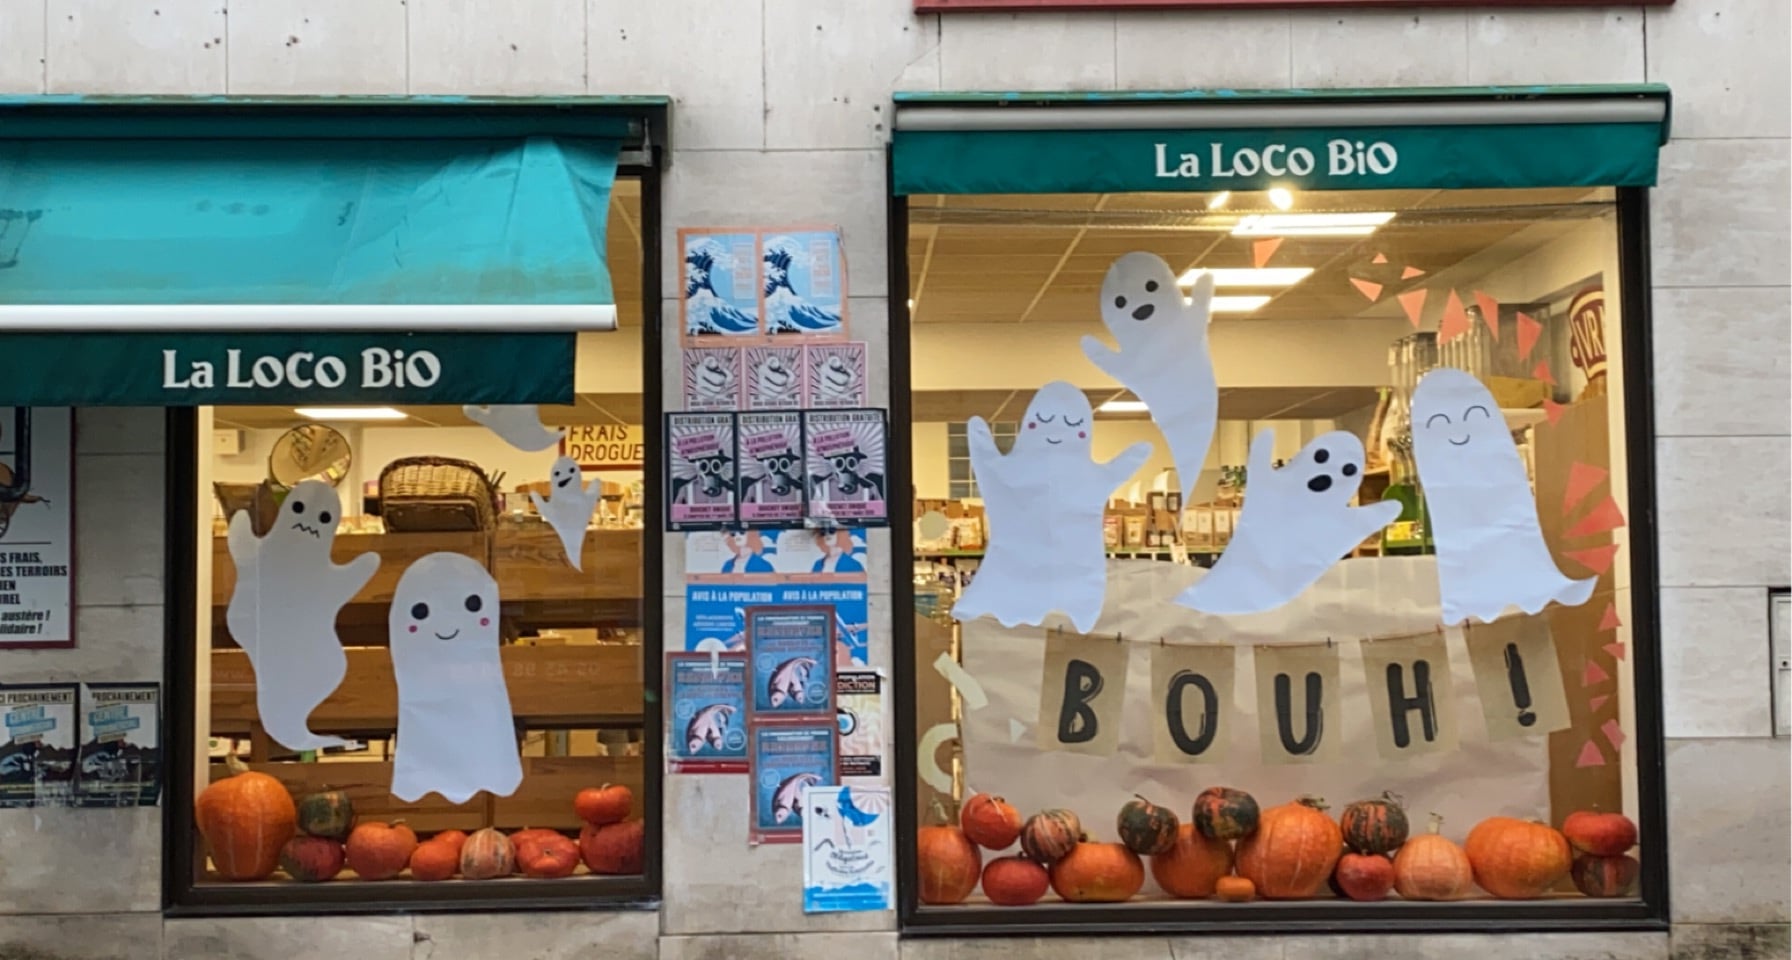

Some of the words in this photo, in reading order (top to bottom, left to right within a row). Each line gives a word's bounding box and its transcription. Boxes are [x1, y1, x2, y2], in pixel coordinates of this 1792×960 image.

[1154, 143, 1201, 178] La
[162, 349, 214, 388] La
[16, 565, 68, 577] TERROIRS
[692, 590, 709, 602] AVIS
[729, 591, 773, 603] POPULATION
[782, 590, 799, 601] AVIS
[819, 590, 863, 601] POPULATION
[8, 691, 73, 702] PROCHAINEMENT
